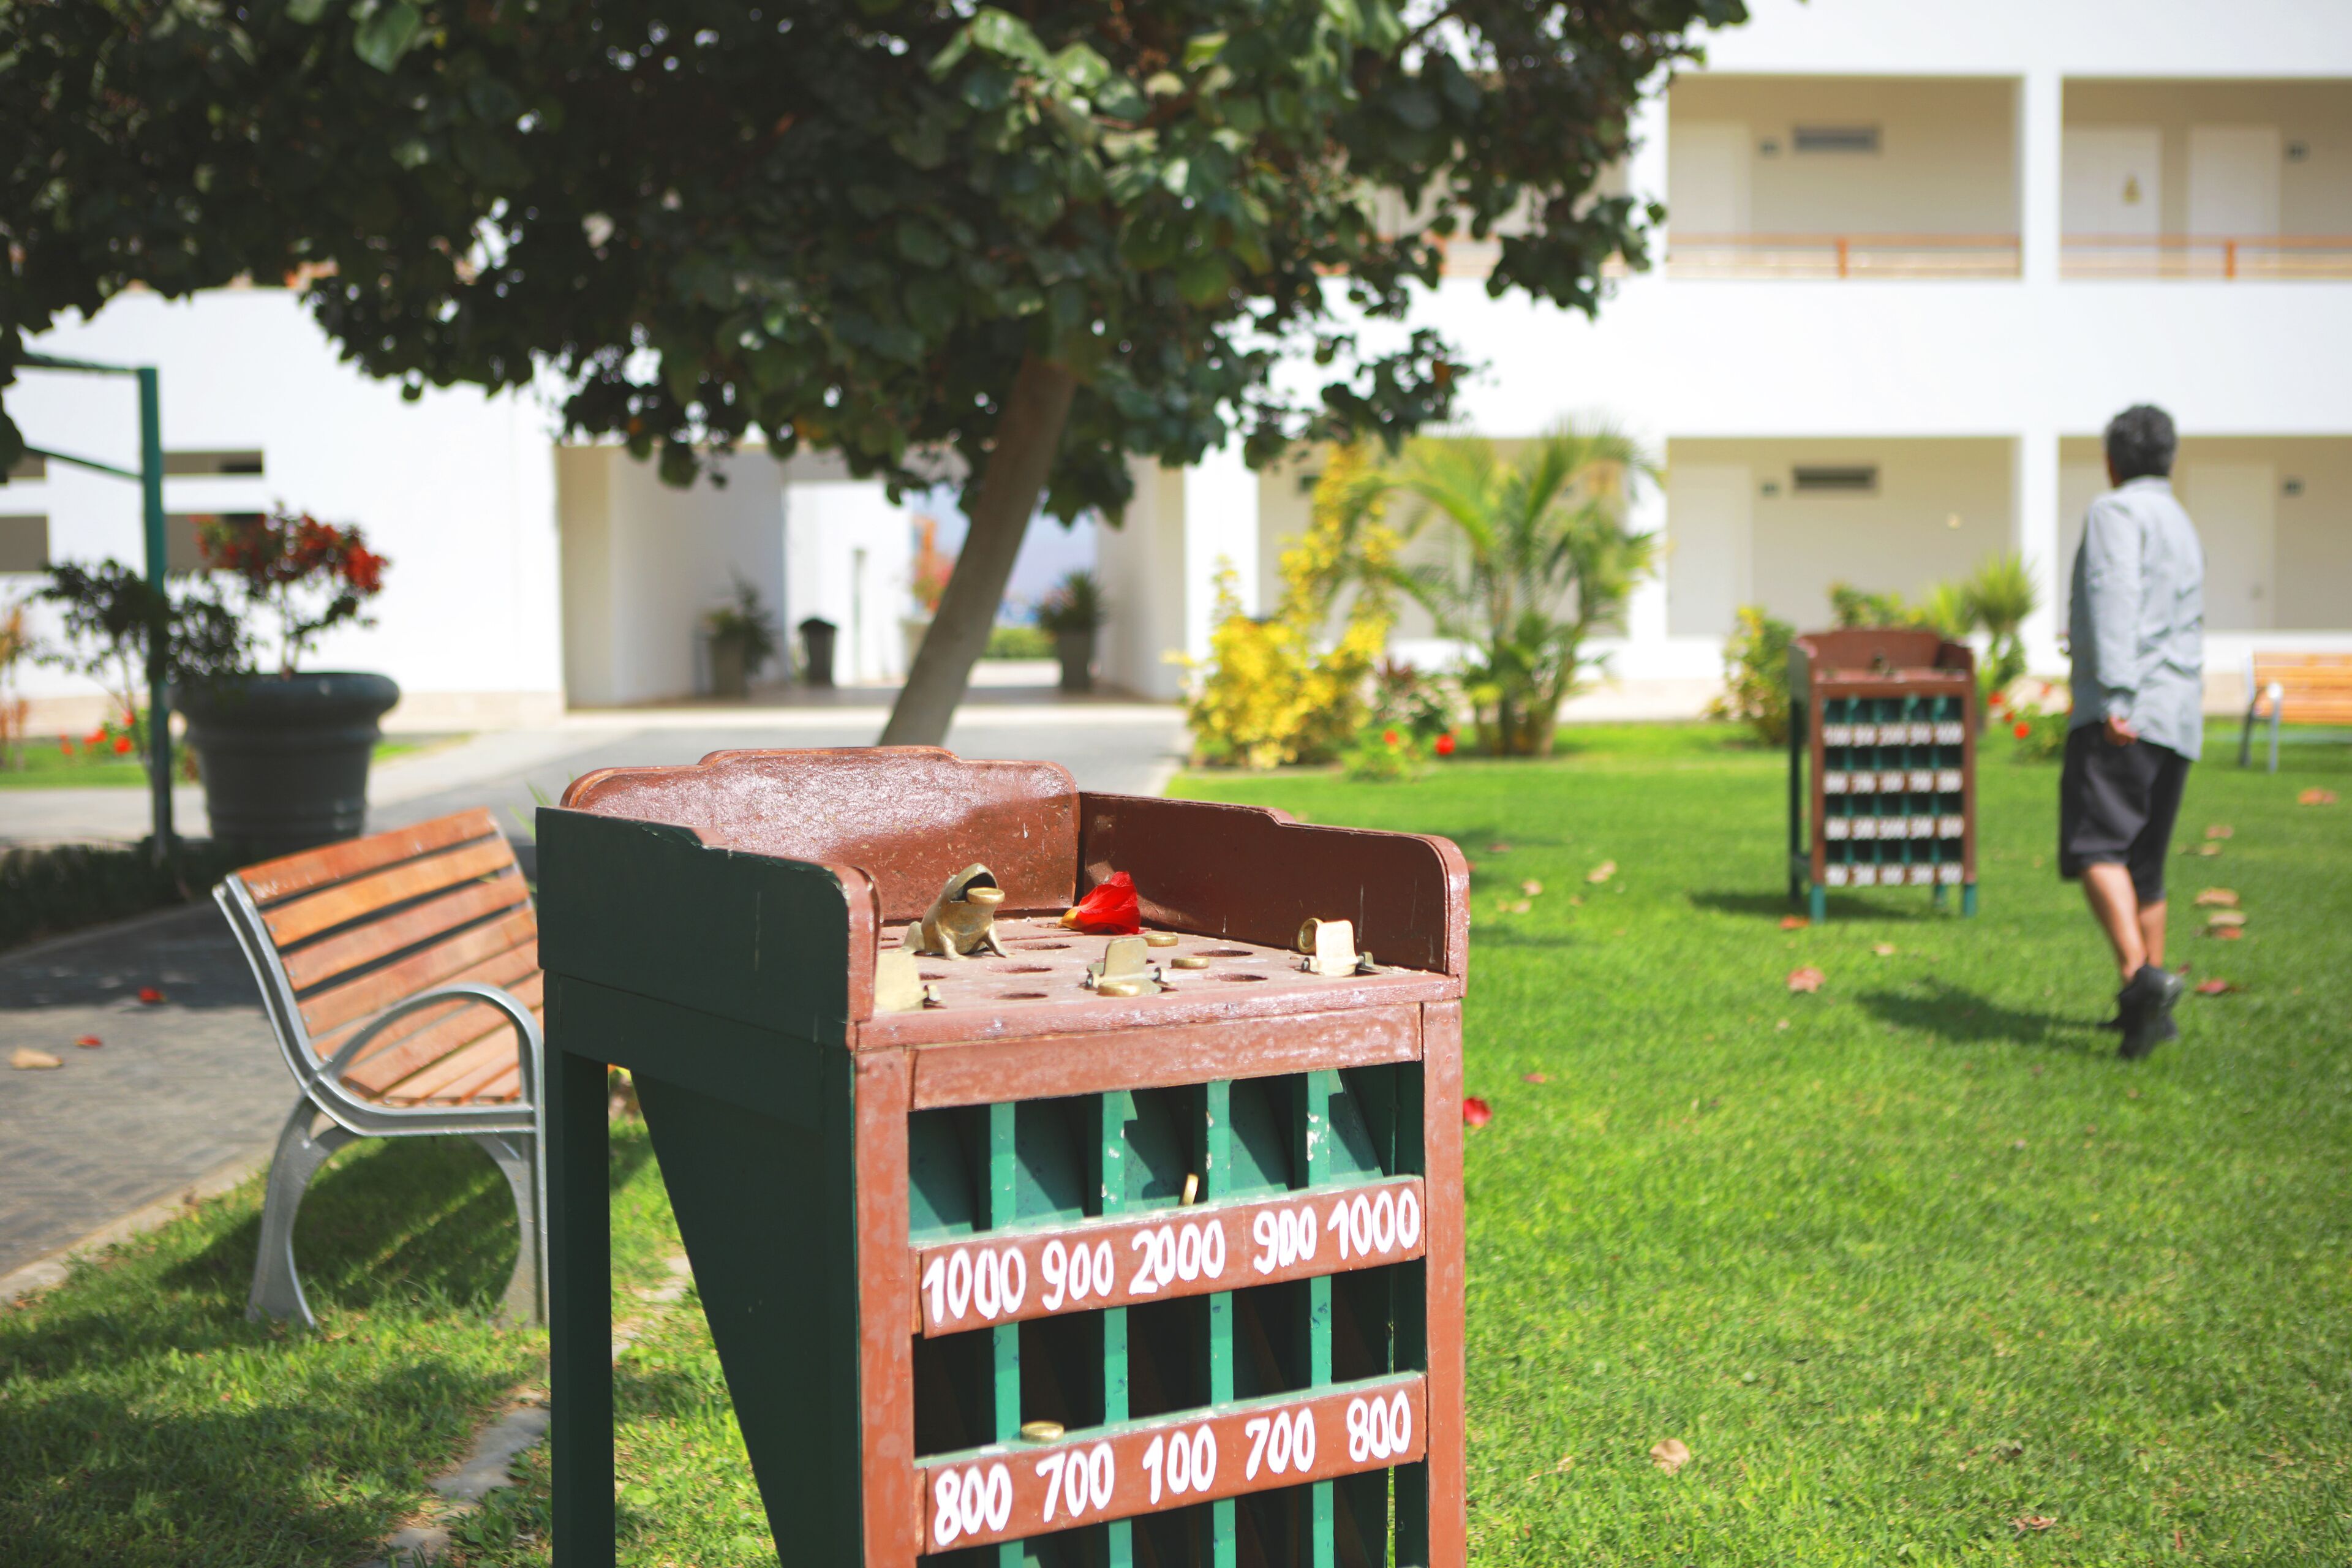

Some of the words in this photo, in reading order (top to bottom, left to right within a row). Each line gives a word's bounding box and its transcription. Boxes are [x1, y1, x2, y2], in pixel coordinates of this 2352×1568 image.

[921, 1246, 1027, 1324] 1000
[1041, 1239, 1114, 1311] 900
[1129, 1219, 1227, 1295] 2000
[1253, 1205, 1319, 1275] 900
[1327, 1187, 1420, 1261] 1000
[934, 1462, 1013, 1547] 800
[1036, 1441, 1115, 1523] 700
[1142, 1423, 1218, 1505] 100
[1245, 1406, 1316, 1481] 700
[1346, 1389, 1412, 1463] 800
